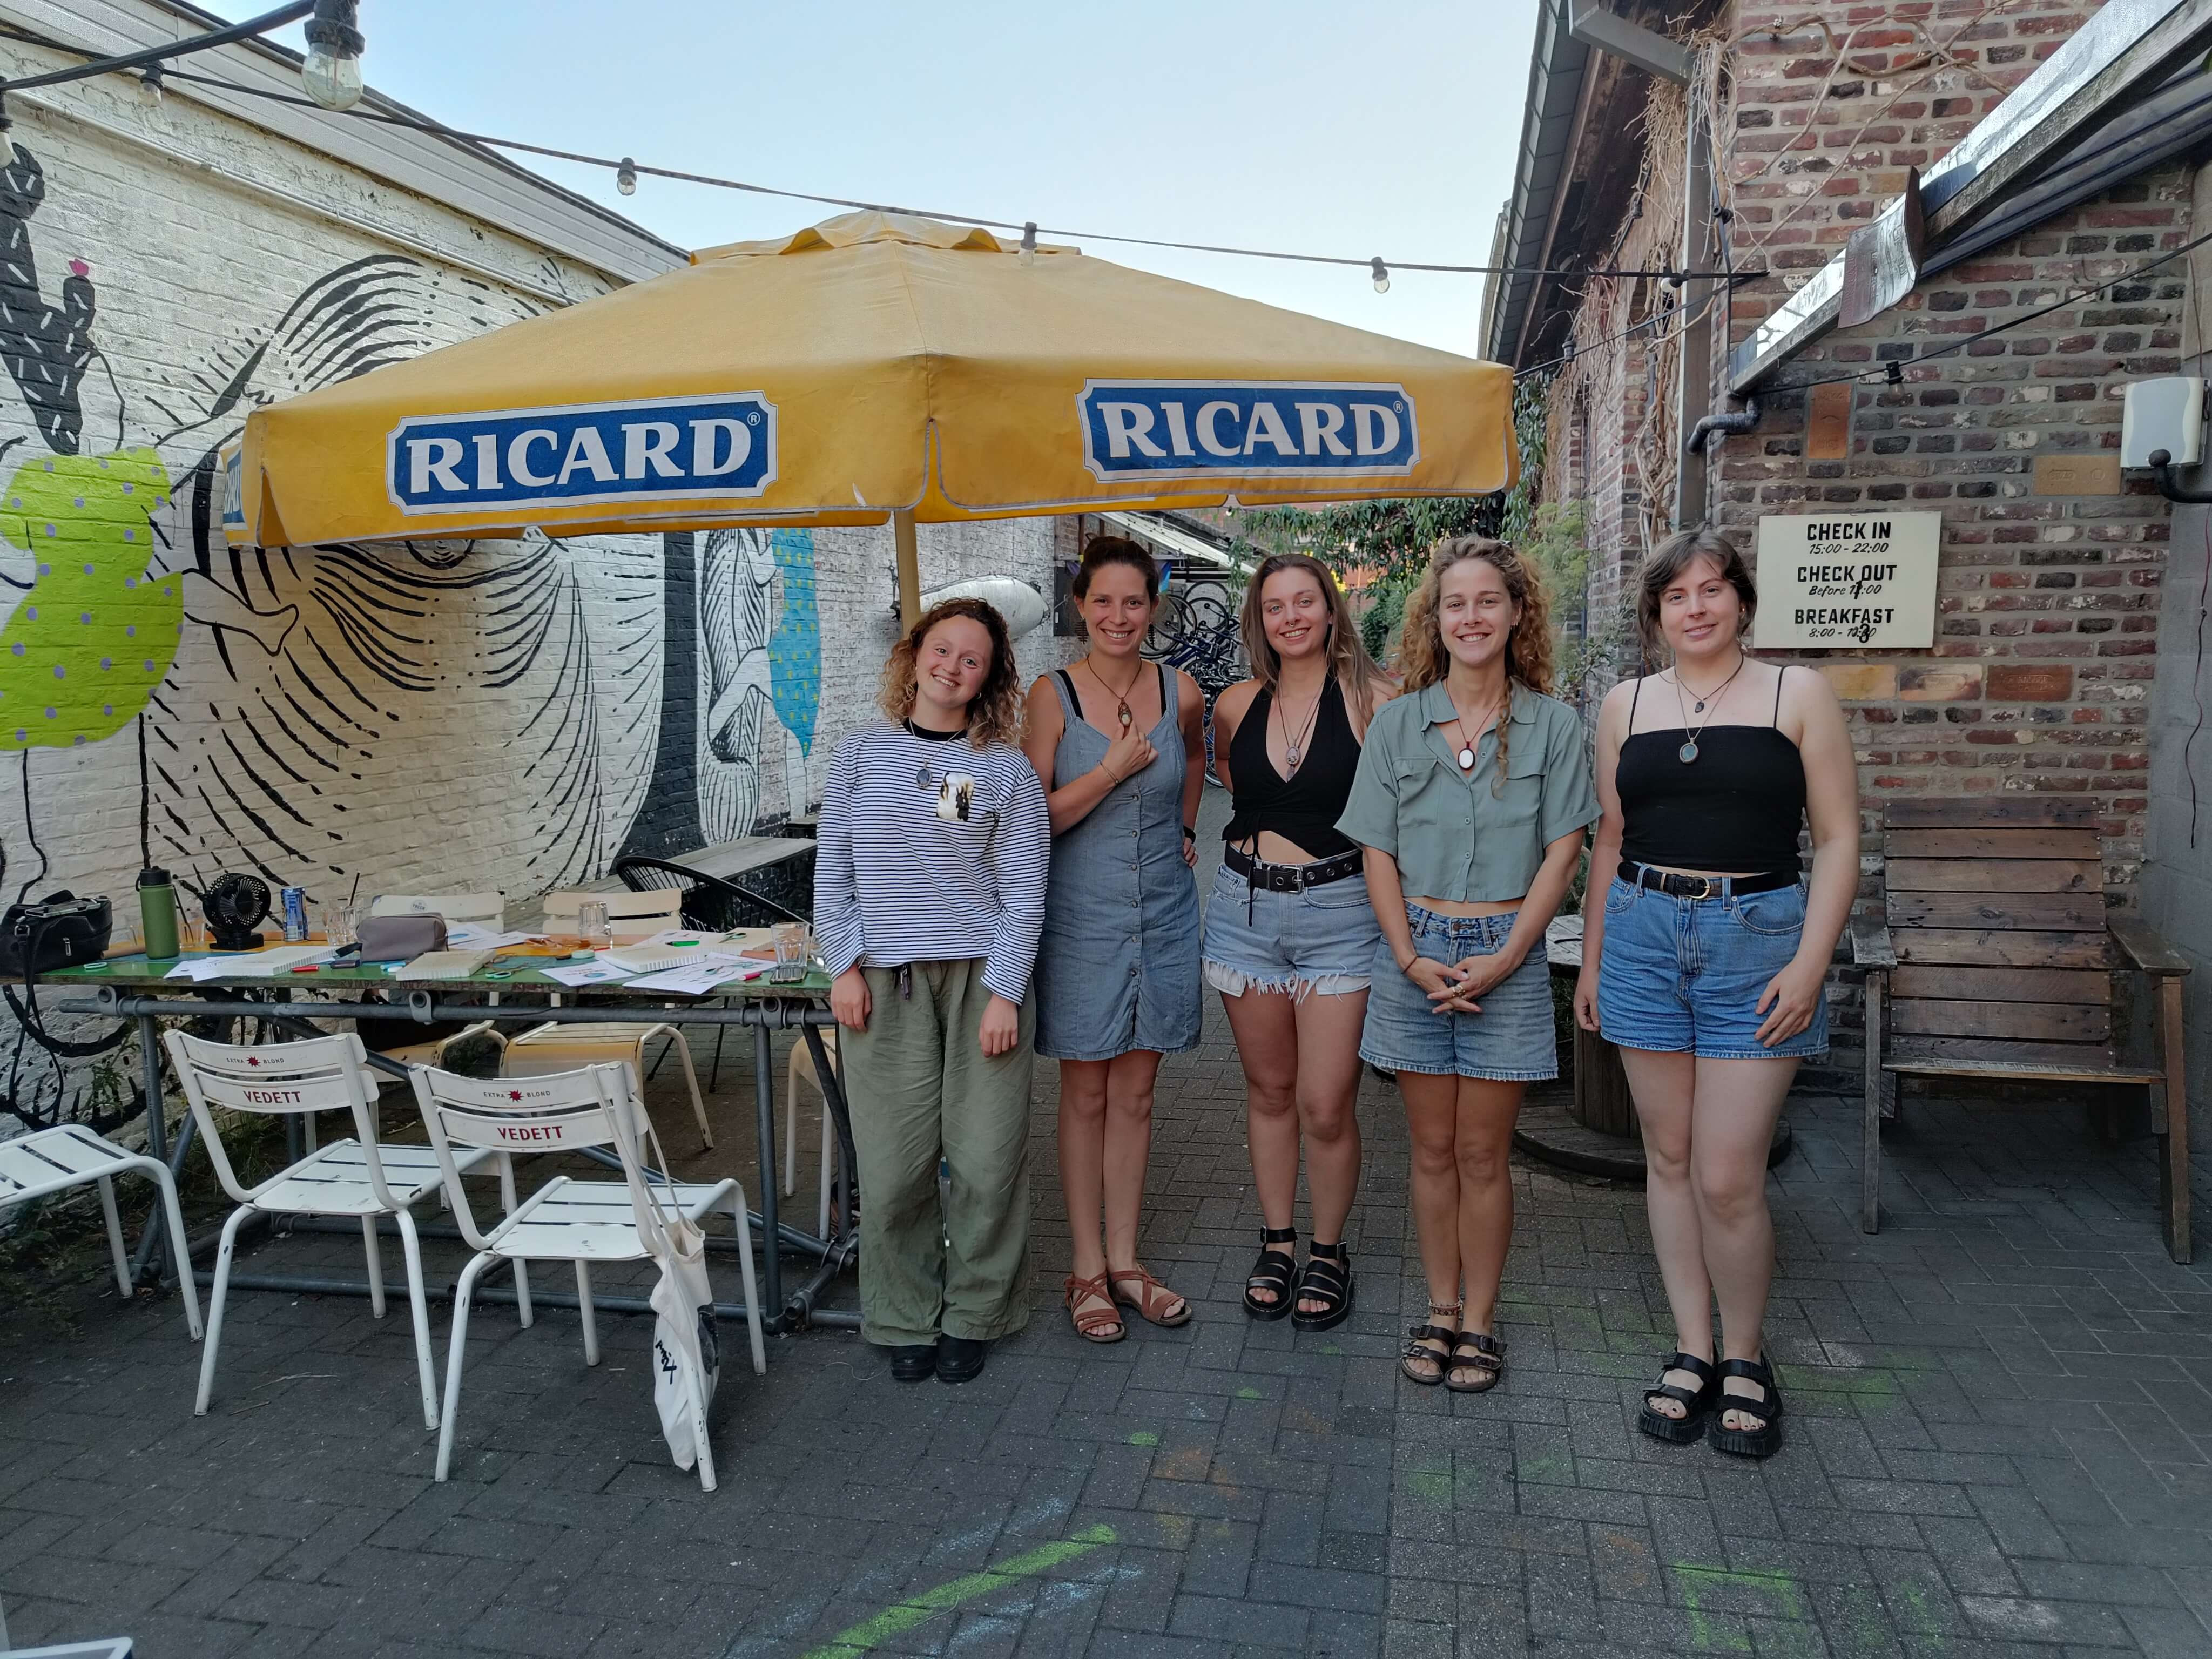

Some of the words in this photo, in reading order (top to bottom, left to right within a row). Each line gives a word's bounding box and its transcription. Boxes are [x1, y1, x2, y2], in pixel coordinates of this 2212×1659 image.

[1807, 522, 1867, 541] CHECK
[1872, 521, 1891, 539] IN
[1810, 543, 1842, 554] 15:00
[1852, 542, 1889, 554] 22:00
[1797, 565, 1856, 582] CHECK
[1862, 564, 1897, 582] OUT
[1808, 585, 1846, 598] Before
[1795, 608, 1894, 625] BREAKFAST
[1809, 628, 1836, 638] 8:00
[243, 1090, 301, 1104] VEDETT
[497, 1125, 562, 1141] VEDETT
